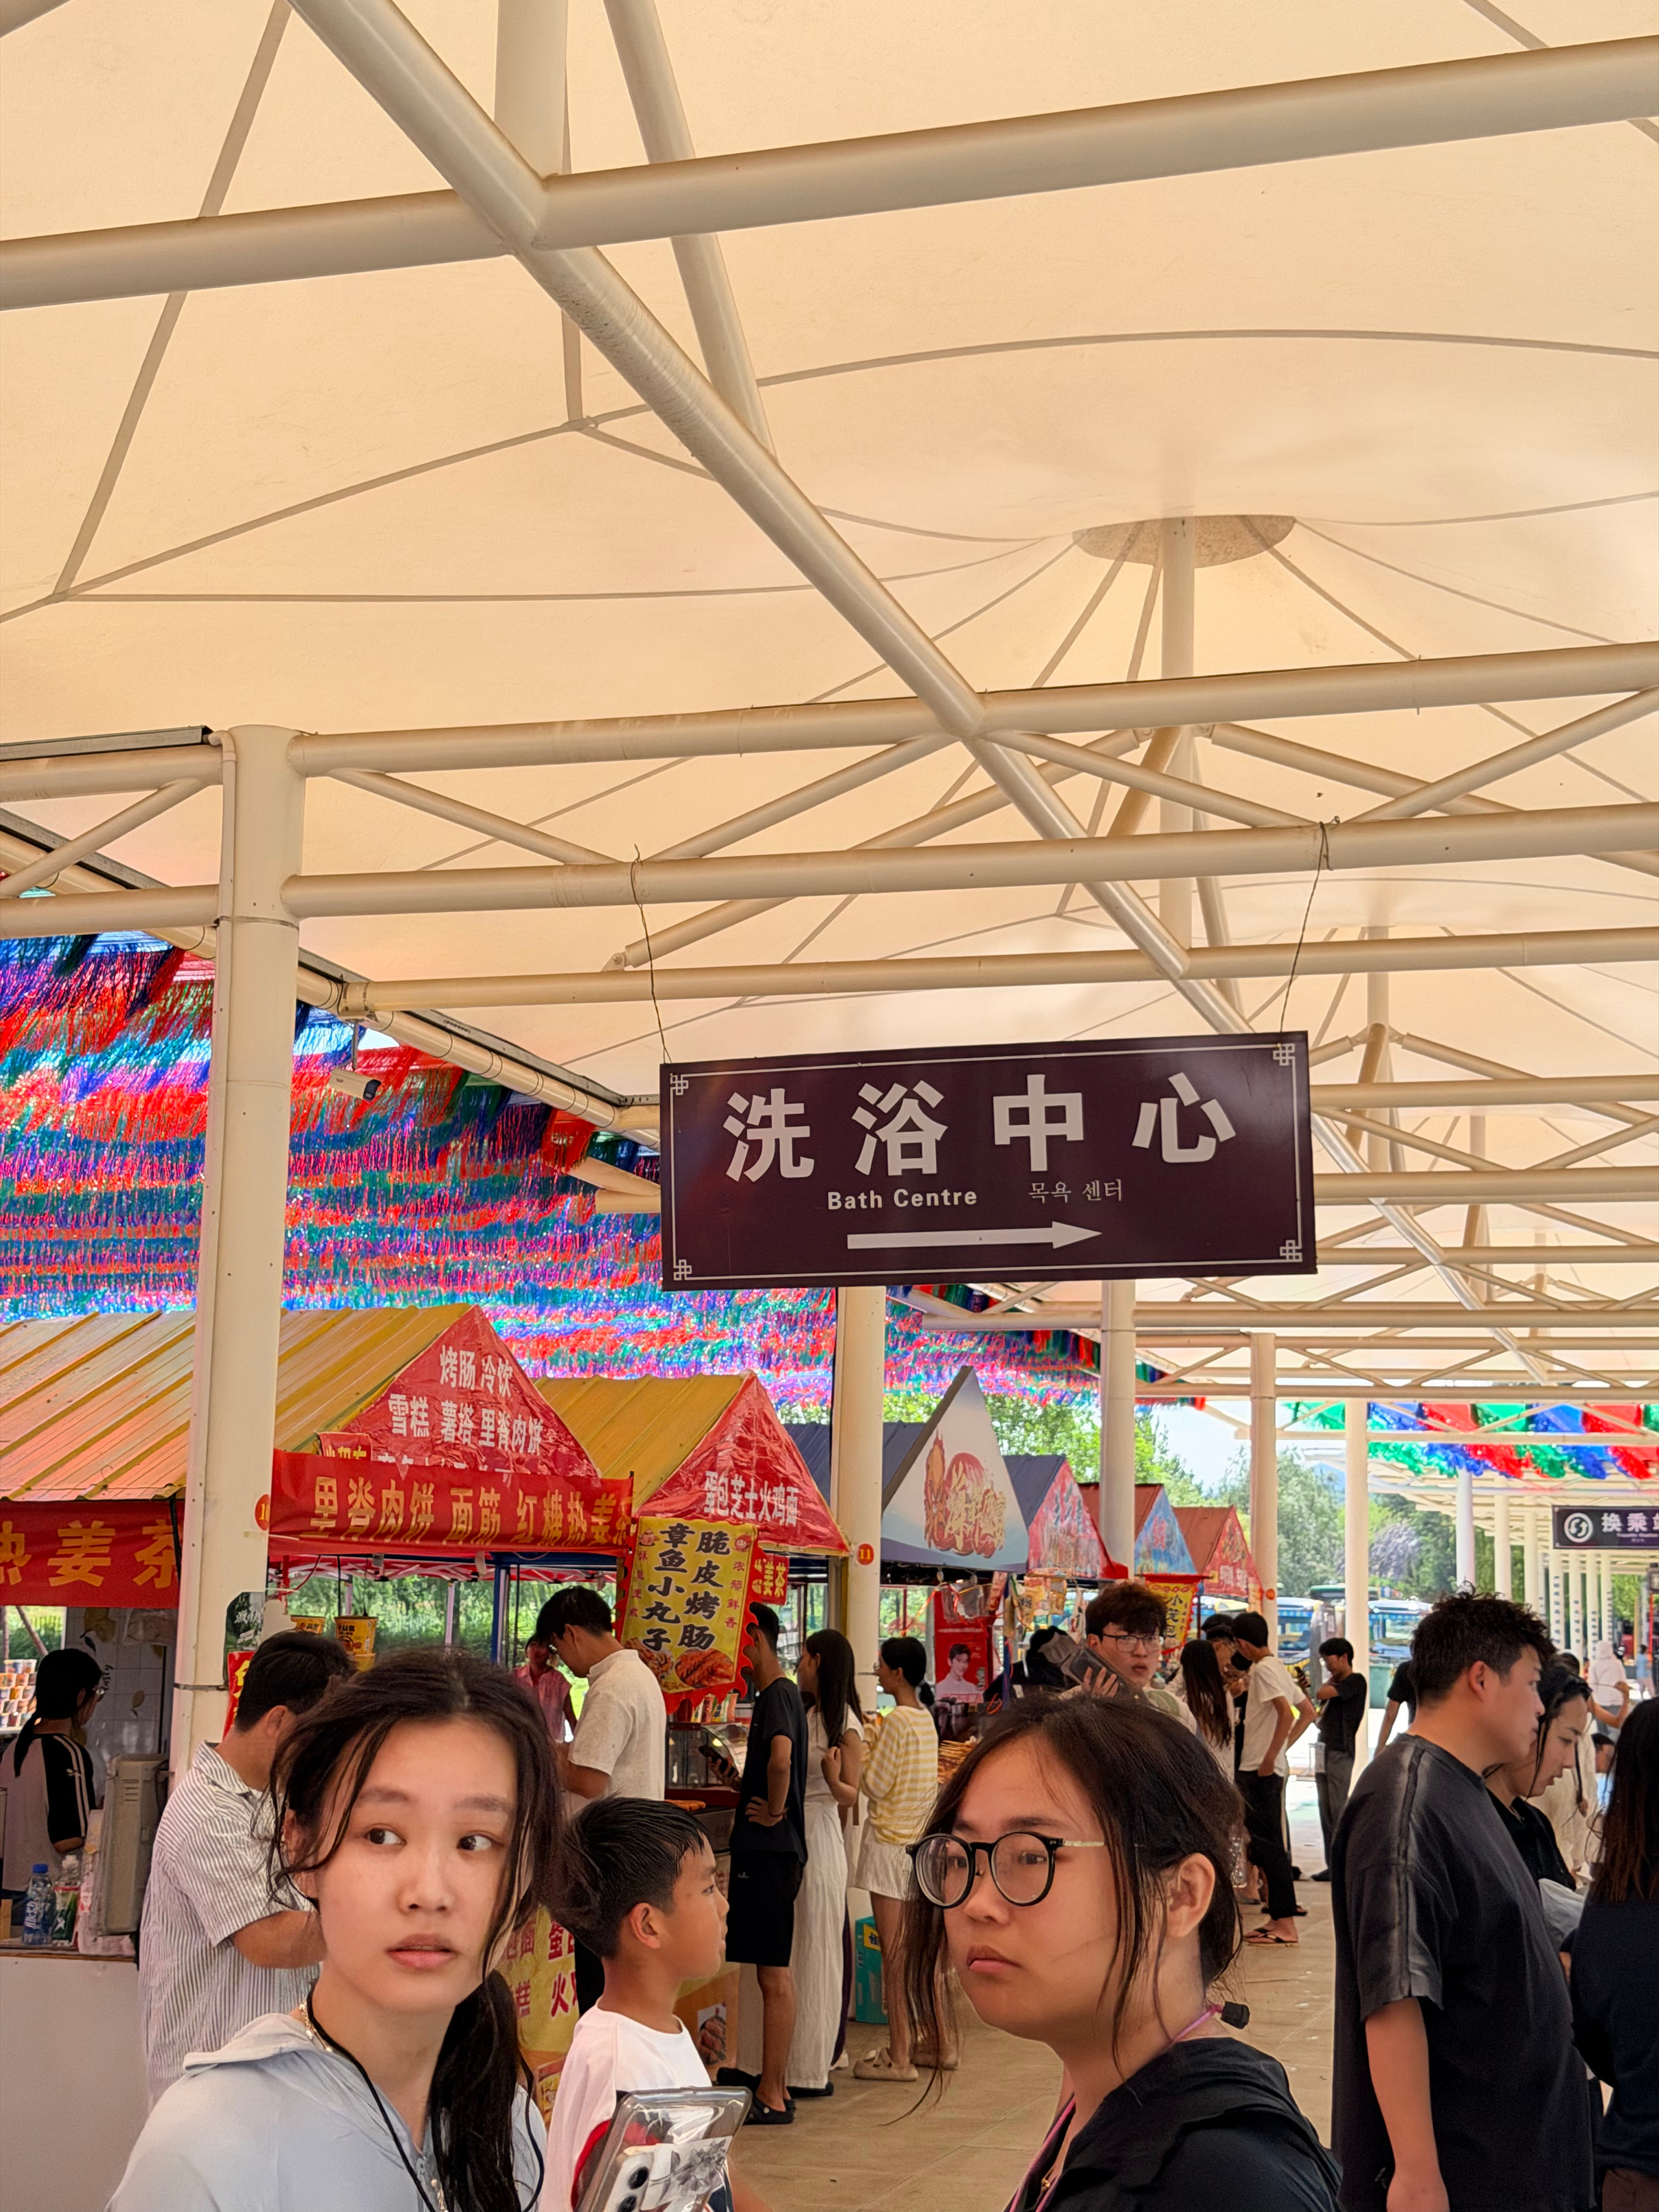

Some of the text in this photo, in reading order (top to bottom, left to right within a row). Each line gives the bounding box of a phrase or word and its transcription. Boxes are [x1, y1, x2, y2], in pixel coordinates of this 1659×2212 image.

[723, 1072, 1236, 1183] 洗浴中心
[827, 1188, 978, 1211] Bath Centre
[1028, 1178, 1123, 1204] 목욕 센터
[440, 1345, 512, 1400] 烤肠 冷饮
[388, 1393, 544, 1457] 雪糕 薯塔 里脊肉饼
[301, 1476, 435, 1544] 里脊肉饼
[442, 1486, 501, 1545] 面筋
[703, 1470, 799, 1527] 蛋包芝士火鸡面
[859, 1549, 872, 1560] 11
[641, 1522, 696, 1651] 章鱼小丸子
[678, 1531, 731, 1650] 脆皮烤肠
